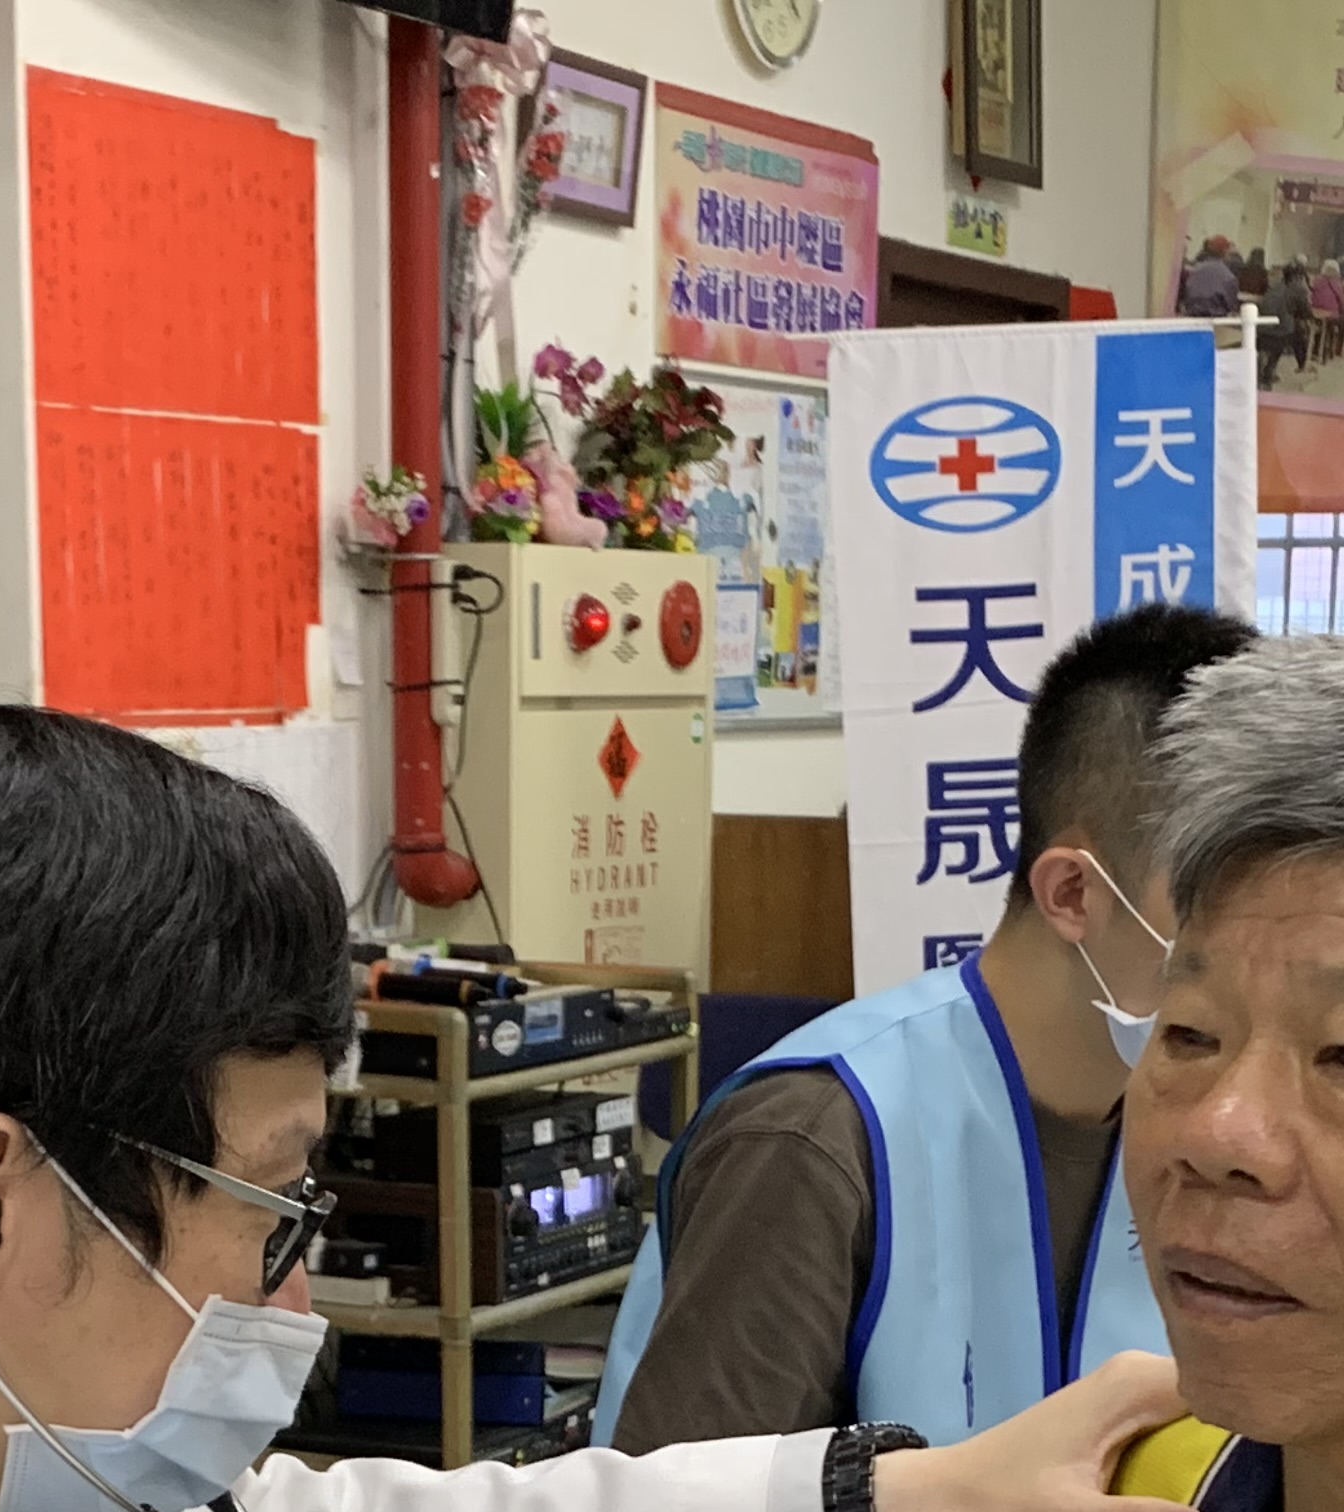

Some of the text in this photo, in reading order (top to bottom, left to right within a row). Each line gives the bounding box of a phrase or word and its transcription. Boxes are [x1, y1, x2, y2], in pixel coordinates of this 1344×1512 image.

[696, 187, 843, 272] 桃園市中壢區
[670, 257, 864, 332] 永福社區發展協會
[571, 810, 658, 858] 消防栓
[570, 861, 658, 893] HYDRANT
